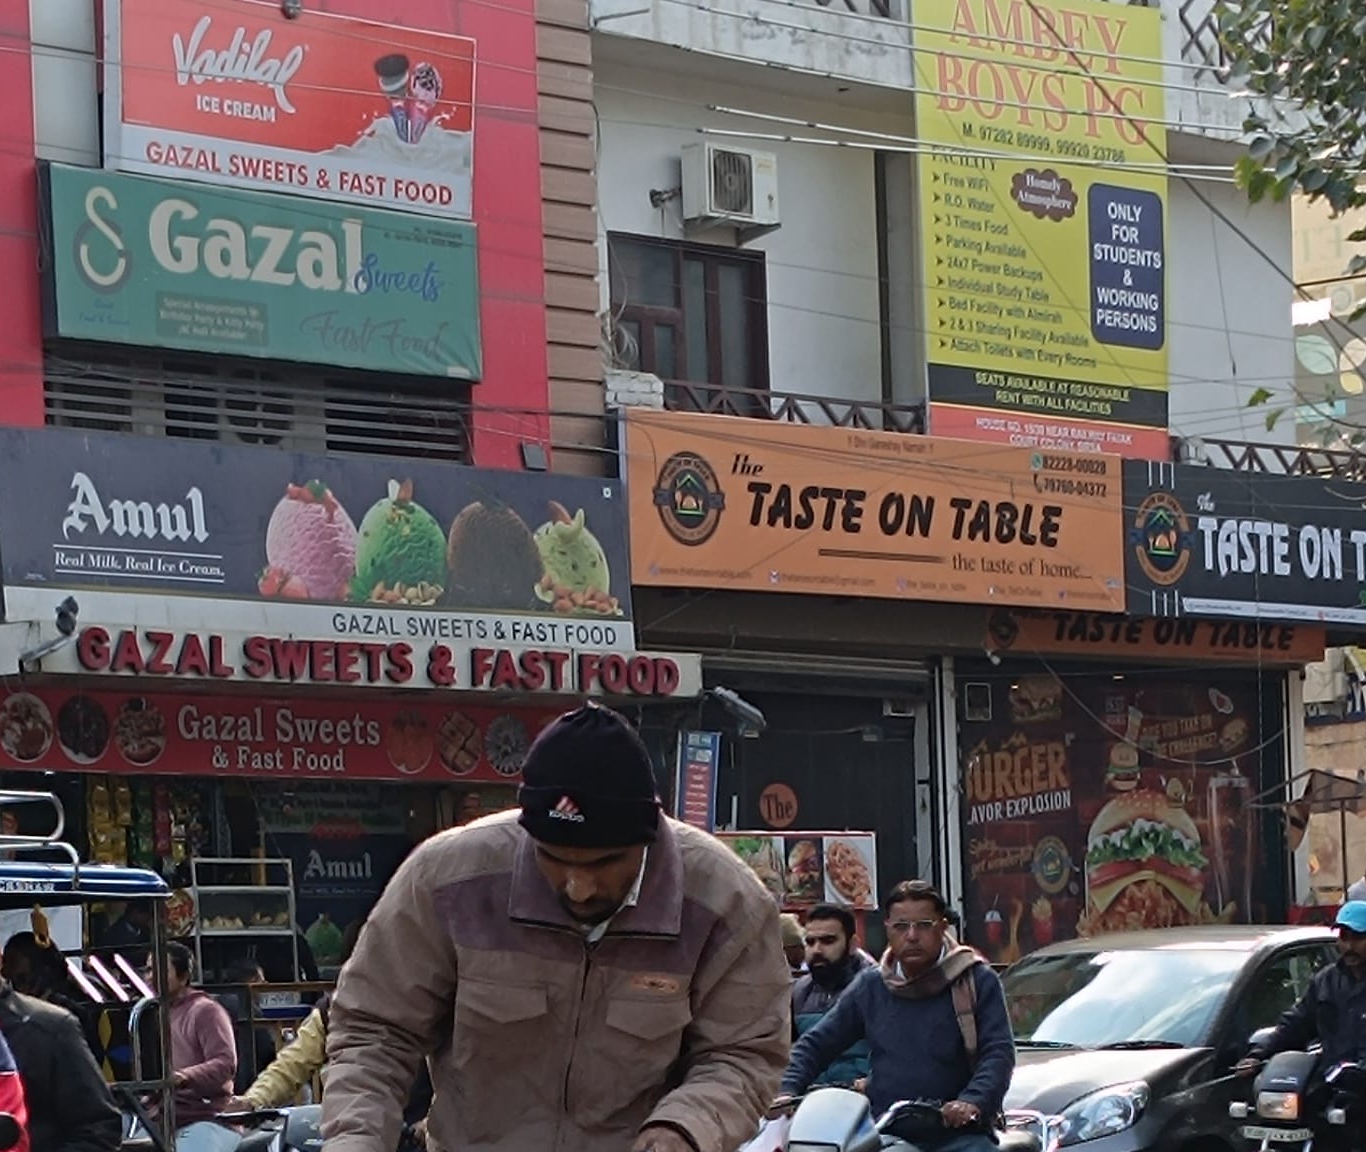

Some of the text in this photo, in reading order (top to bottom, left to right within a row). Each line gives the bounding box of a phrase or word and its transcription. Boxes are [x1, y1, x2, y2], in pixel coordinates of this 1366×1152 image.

[949, 0, 1127, 75] AMBEY
[172, 16, 303, 113] Vadilal
[196, 94, 275, 122] ICE CREAM
[937, 51, 1147, 145] BOYS PG
[146, 141, 452, 206] GAZAL SWEETS & FAST FOOD
[1107, 202, 1143, 222] ONLY
[149, 199, 441, 300] Gazal Sweets
[1112, 225, 1139, 243] FOR
[1093, 243, 1162, 269] STUDENTS
[1123, 269, 1132, 286] &
[1097, 287, 1159, 311] WORKING
[1096, 309, 1157, 332] PERSONS
[732, 454, 763, 476] The
[63, 472, 209, 543] Amul
[747, 482, 867, 533] TASTE
[879, 492, 936, 539] ON
[950, 498, 1063, 547] TABLE
[55, 551, 225, 576] Real Milk. Real Ice Cream.
[1197, 516, 1292, 577] TASTE
[1299, 524, 1342, 580] ON
[952, 554, 977, 572] the
[981, 557, 1014, 574] taste
[1019, 558, 1037, 576] of
[333, 612, 616, 646] GAZAL SWEETS & FAST FOOD
[1053, 613, 1293, 651] TASTE ON TABLE
[77, 627, 681, 697] GAZAL SWEETS & FAST FOOD
[178, 705, 382, 746] Gazal Sweets
[211, 747, 346, 772] & Fast Food
[763, 793, 794, 822] The
[968, 789, 1071, 826] AVOR EXPLOSION
[303, 850, 373, 880] Amul
